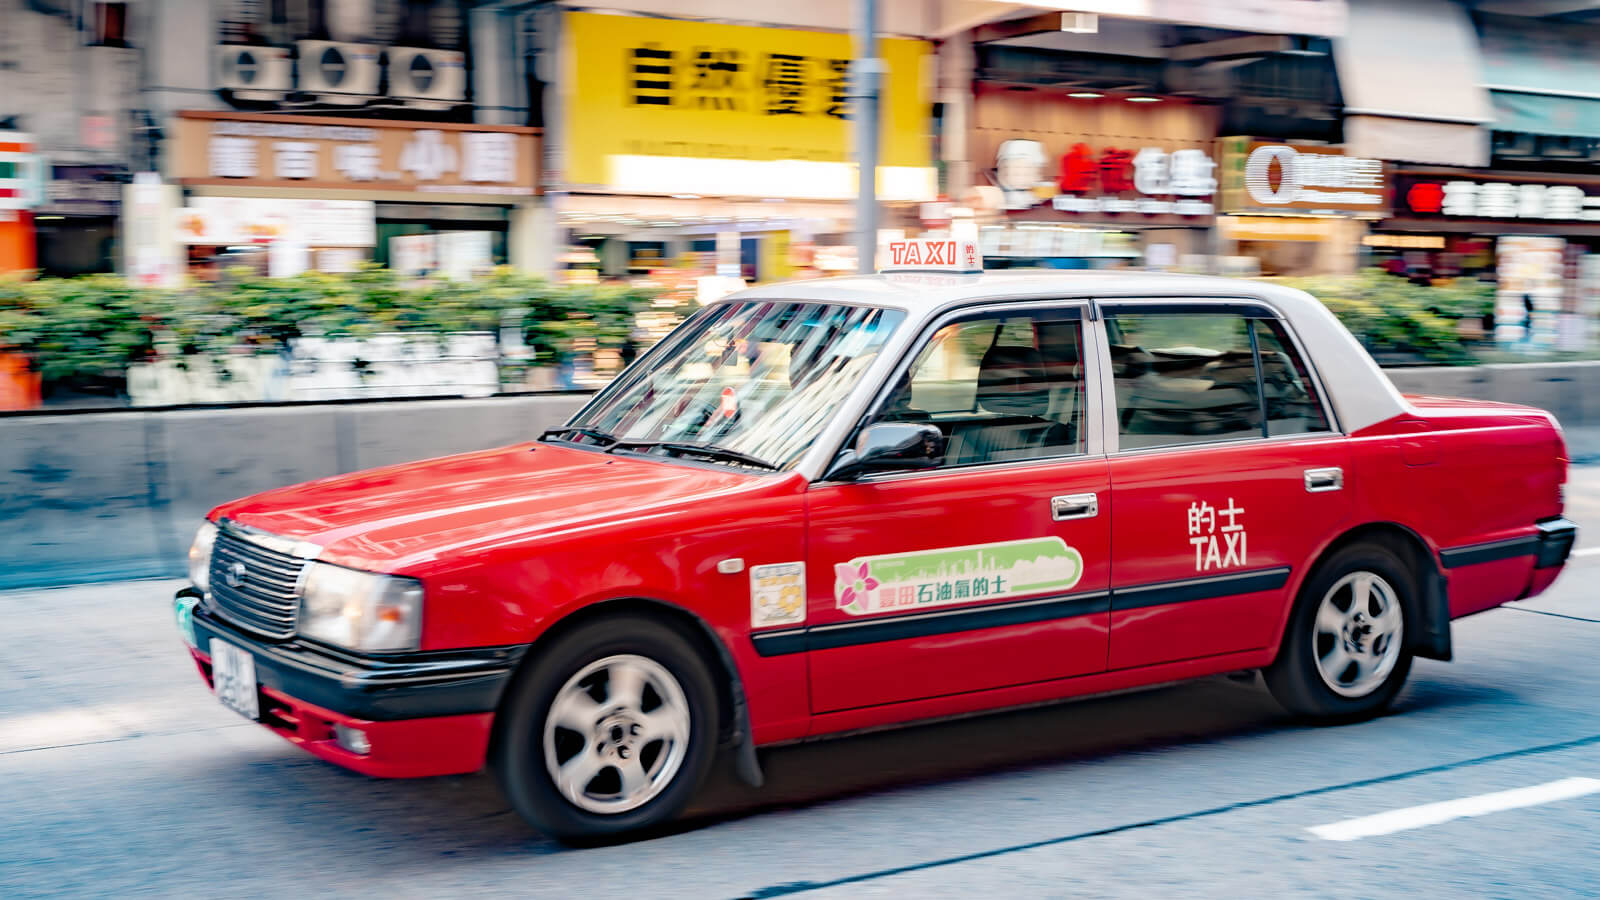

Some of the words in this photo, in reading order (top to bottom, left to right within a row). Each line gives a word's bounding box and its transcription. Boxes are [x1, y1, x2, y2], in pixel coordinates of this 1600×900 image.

[889, 241, 957, 265] TAXI
[965, 243, 976, 265] 的士
[1187, 497, 1245, 536] 的士
[1189, 531, 1247, 571] TAXI
